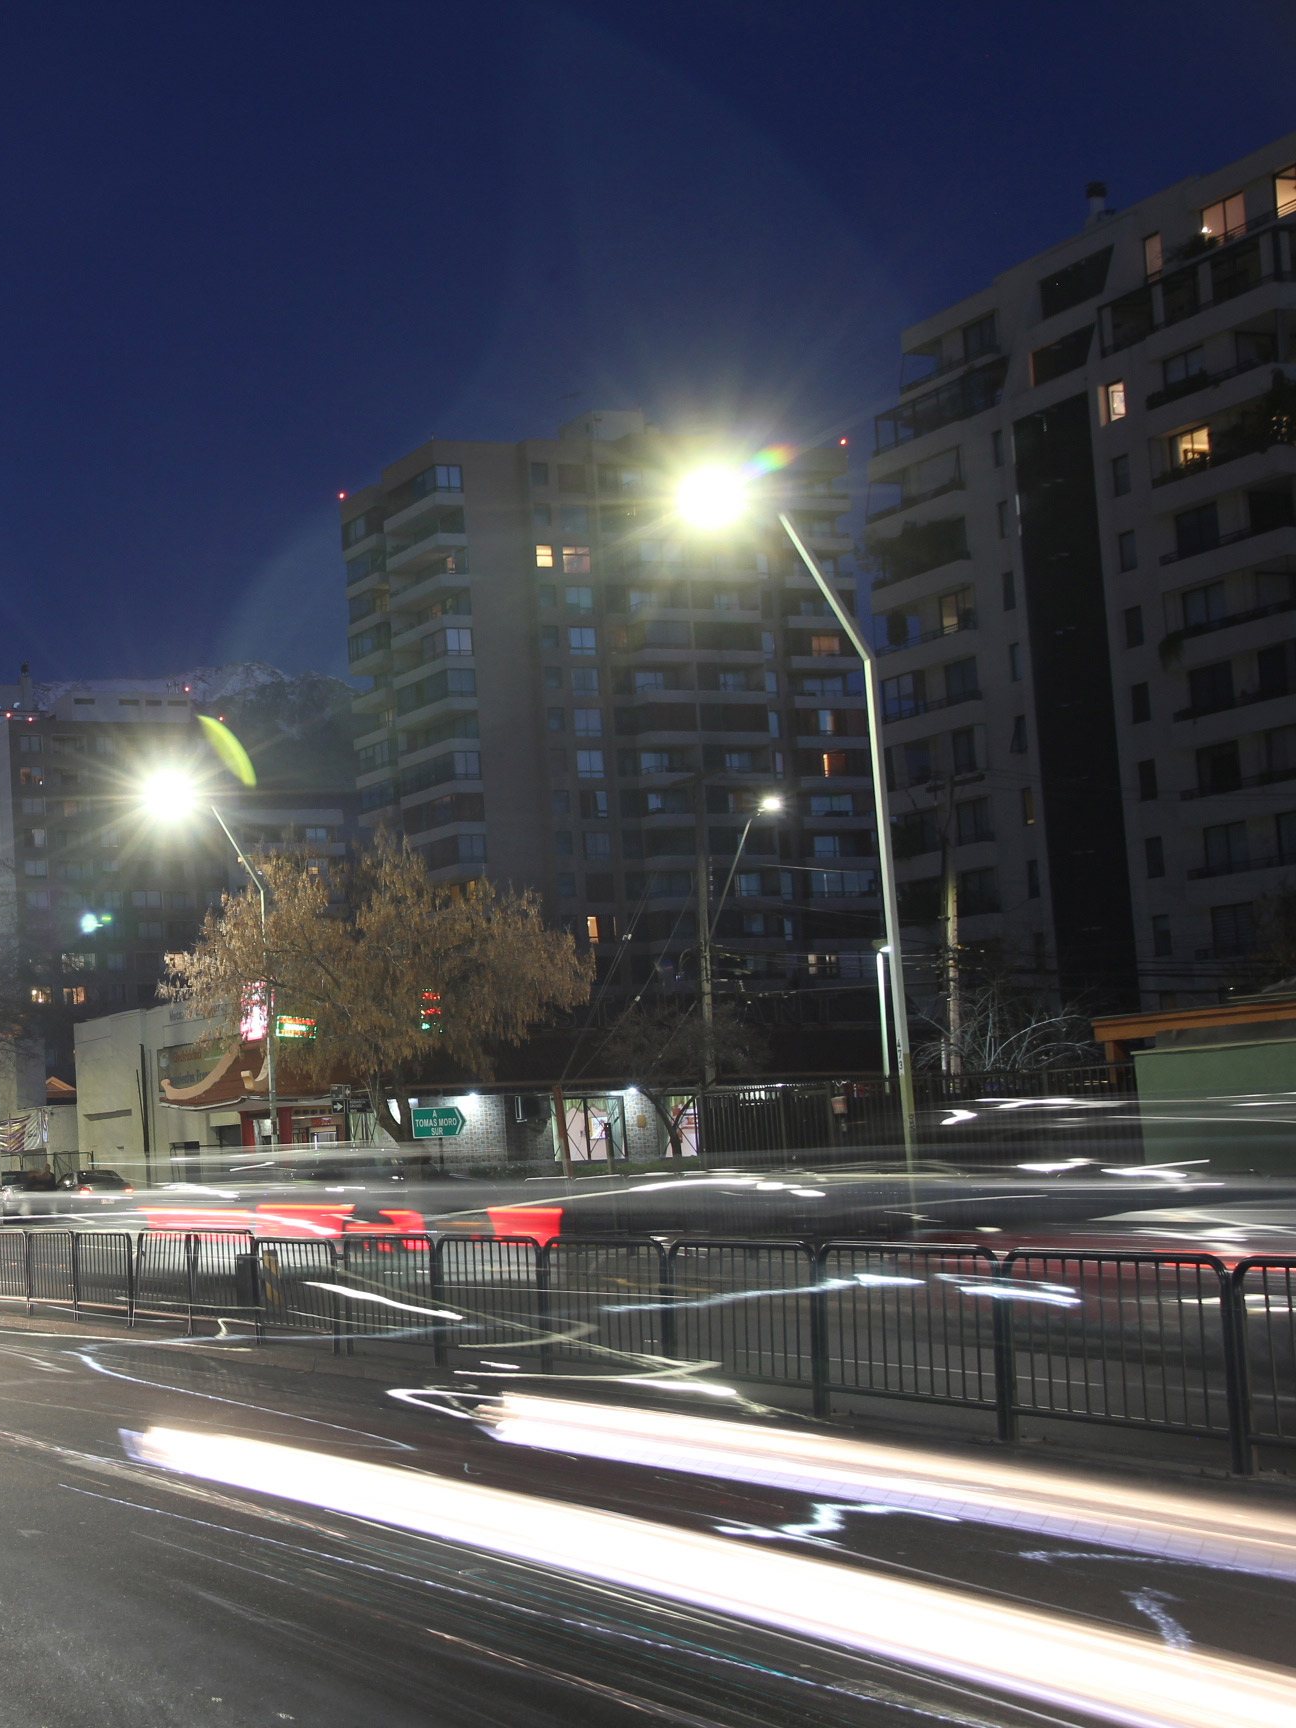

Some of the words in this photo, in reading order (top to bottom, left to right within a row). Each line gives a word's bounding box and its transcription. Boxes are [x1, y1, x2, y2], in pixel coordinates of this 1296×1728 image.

[432, 1109, 438, 1118] A
[415, 1118, 437, 1127] TOMAS
[438, 1117, 457, 1127] MORO
[430, 1127, 444, 1136] SUR
